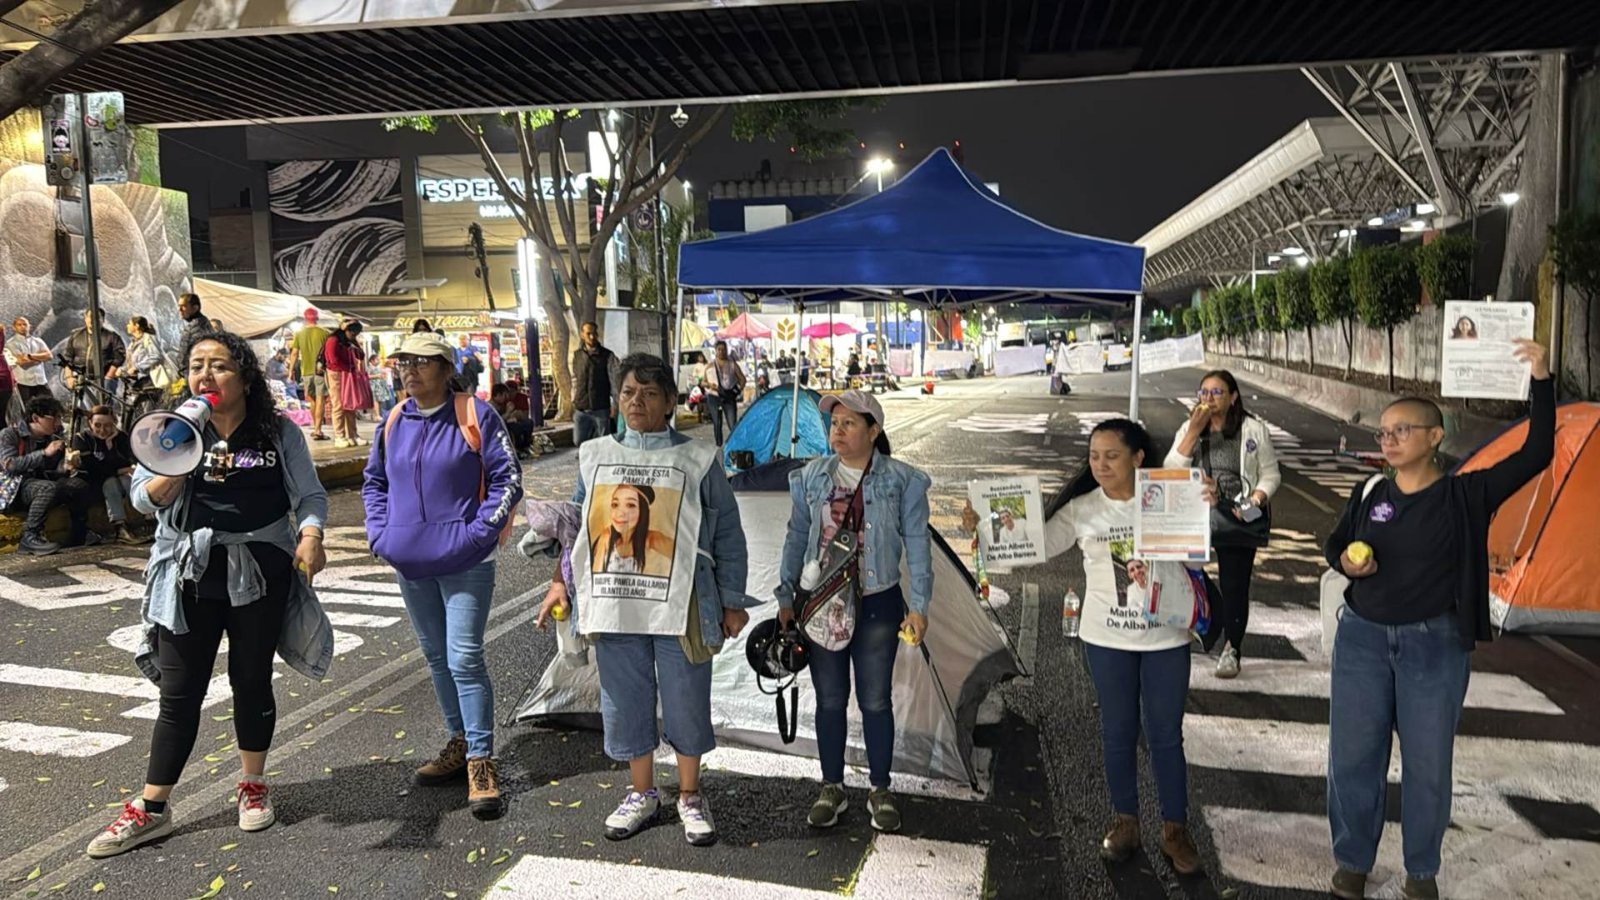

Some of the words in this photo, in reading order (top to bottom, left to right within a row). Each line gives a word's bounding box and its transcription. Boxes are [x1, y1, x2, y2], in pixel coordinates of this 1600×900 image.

[420, 179, 579, 200] ESPERAZA
[434, 315, 478, 328] TORTAS
[1009, 542, 1034, 551] Alberto
[998, 552, 1012, 560] Alba
[614, 577, 636, 587] PAMELA
[1110, 607, 1138, 618] Mario
[1106, 618, 1121, 628] De
[1123, 620, 1146, 630] Alba
